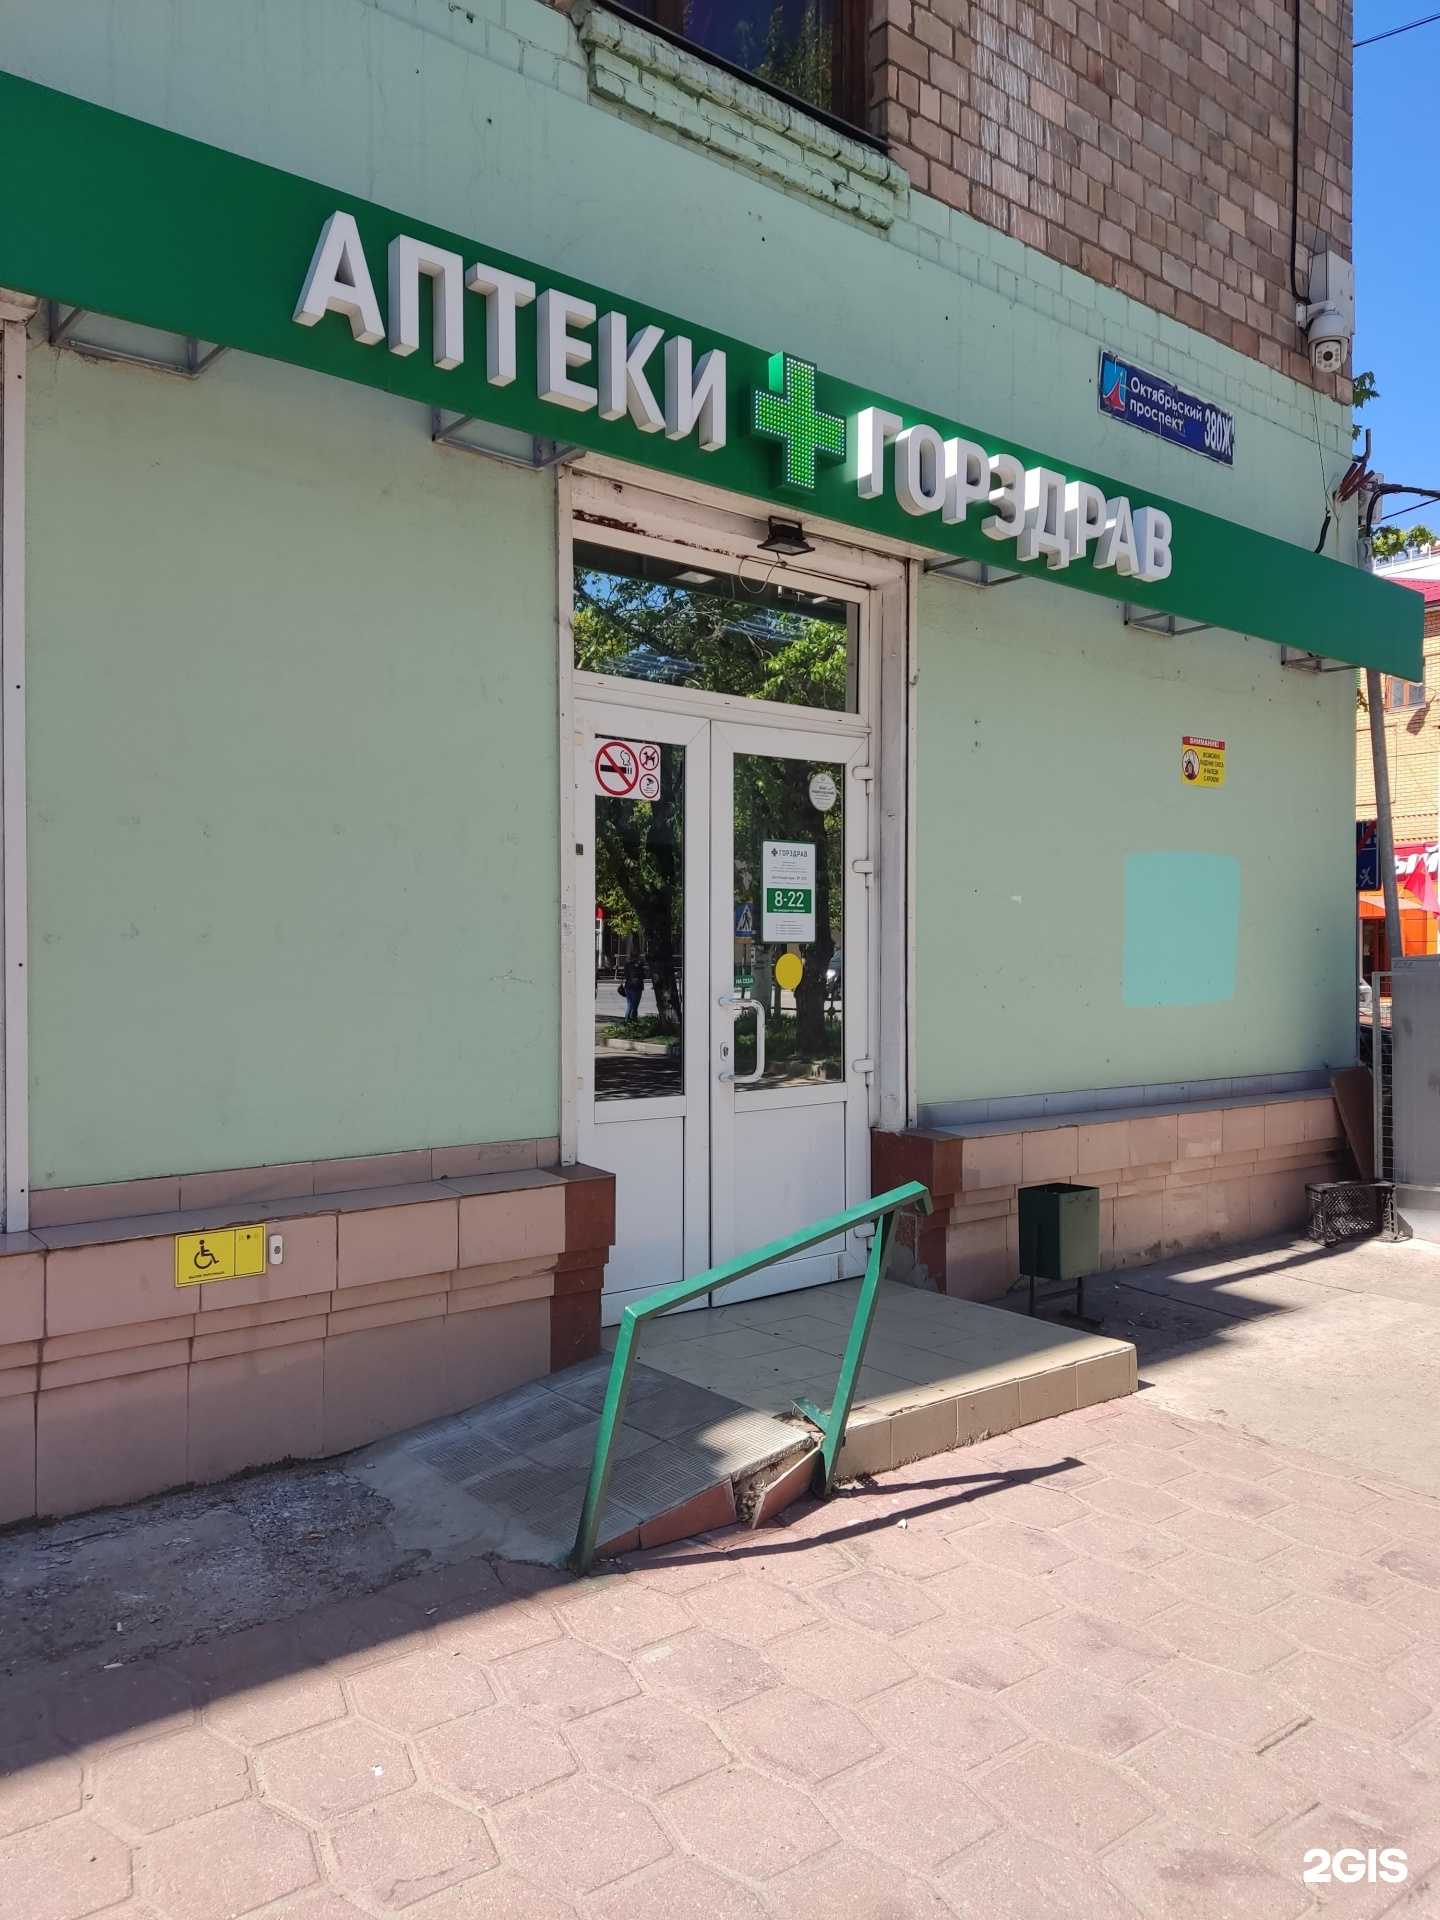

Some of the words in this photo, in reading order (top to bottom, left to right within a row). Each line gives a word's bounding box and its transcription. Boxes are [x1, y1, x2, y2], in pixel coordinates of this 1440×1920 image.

[292, 210, 727, 452] АПТЕКИ
[857, 406, 1173, 583] ГОРЗДРАВ
[1129, 398, 1184, 431] проспект
[1130, 377, 1202, 422] Октябрьский
[1204, 408, 1233, 456] 380Ж
[774, 890, 804, 907] 8-22
